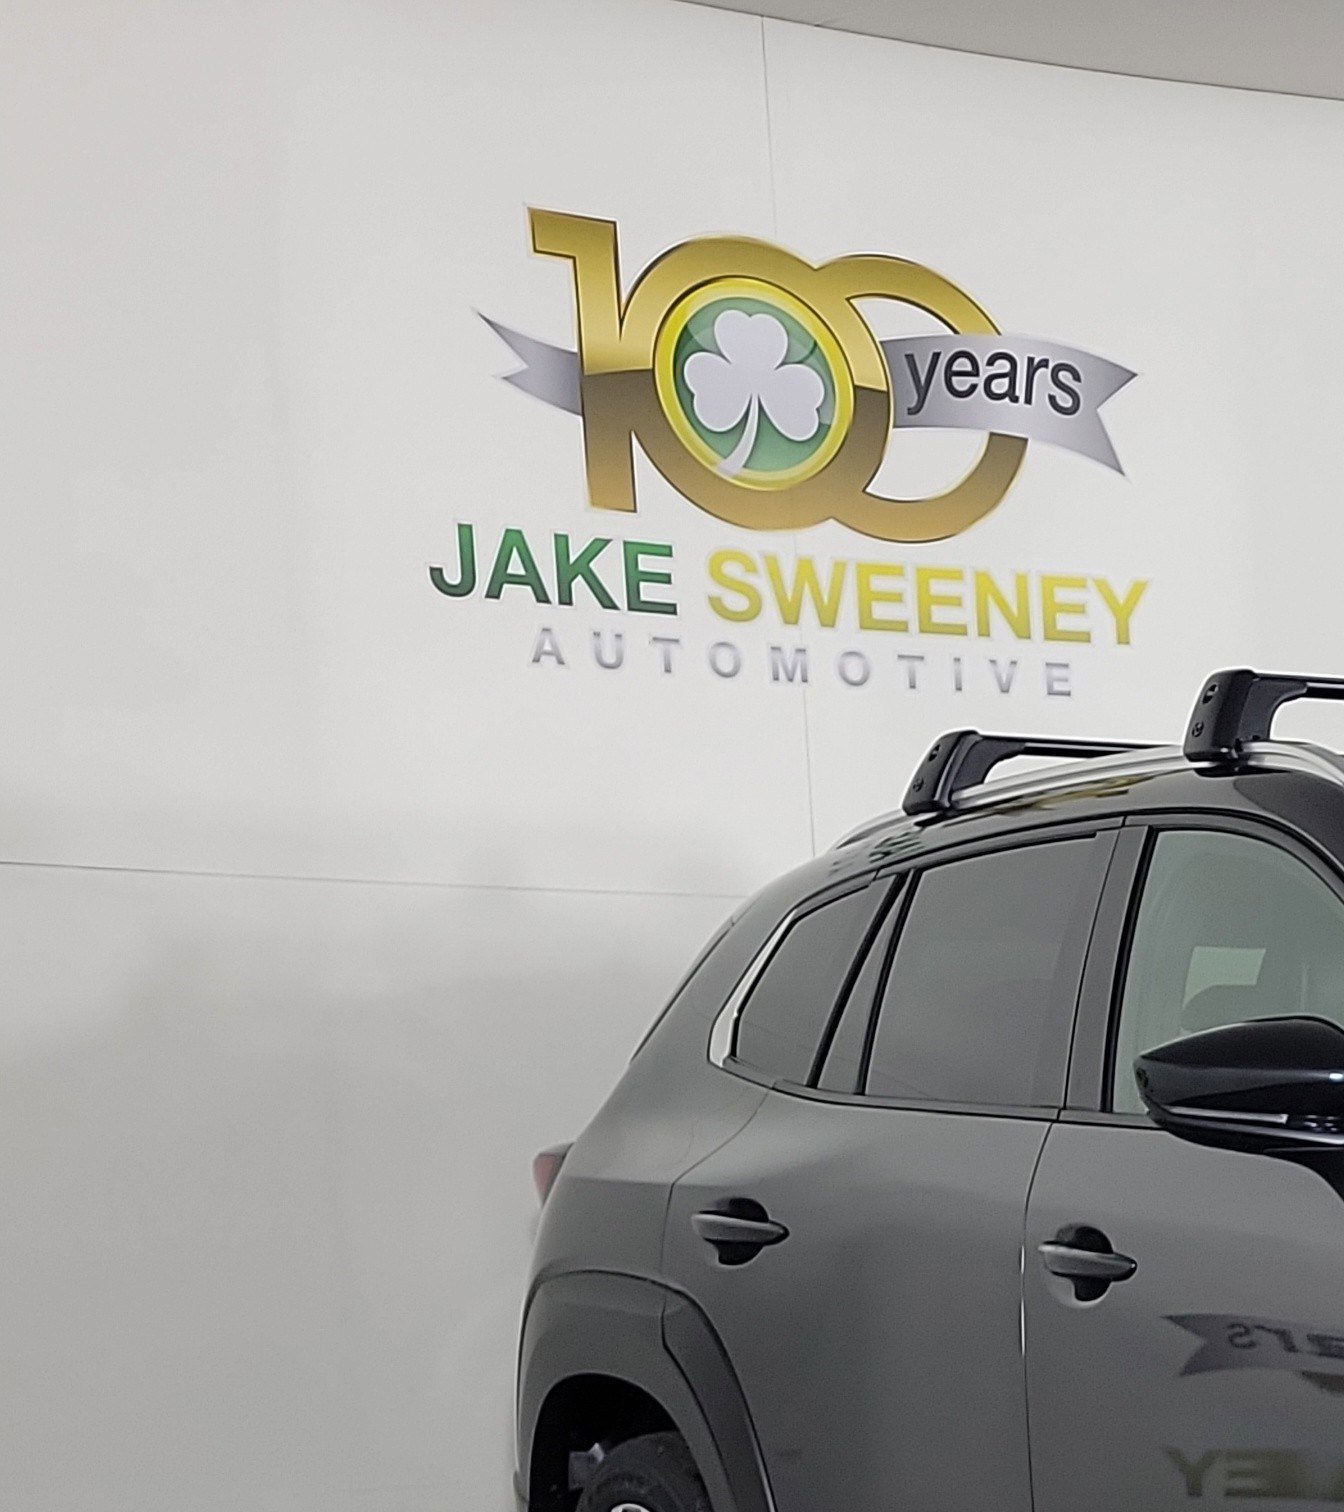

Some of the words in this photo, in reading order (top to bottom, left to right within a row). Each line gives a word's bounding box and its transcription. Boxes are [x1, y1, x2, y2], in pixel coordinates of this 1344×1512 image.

[904, 349, 1083, 417] years
[428, 521, 679, 617] JAKE
[705, 548, 1149, 647] SWEENEY
[530, 626, 1073, 698] AUTOMOTIVE
